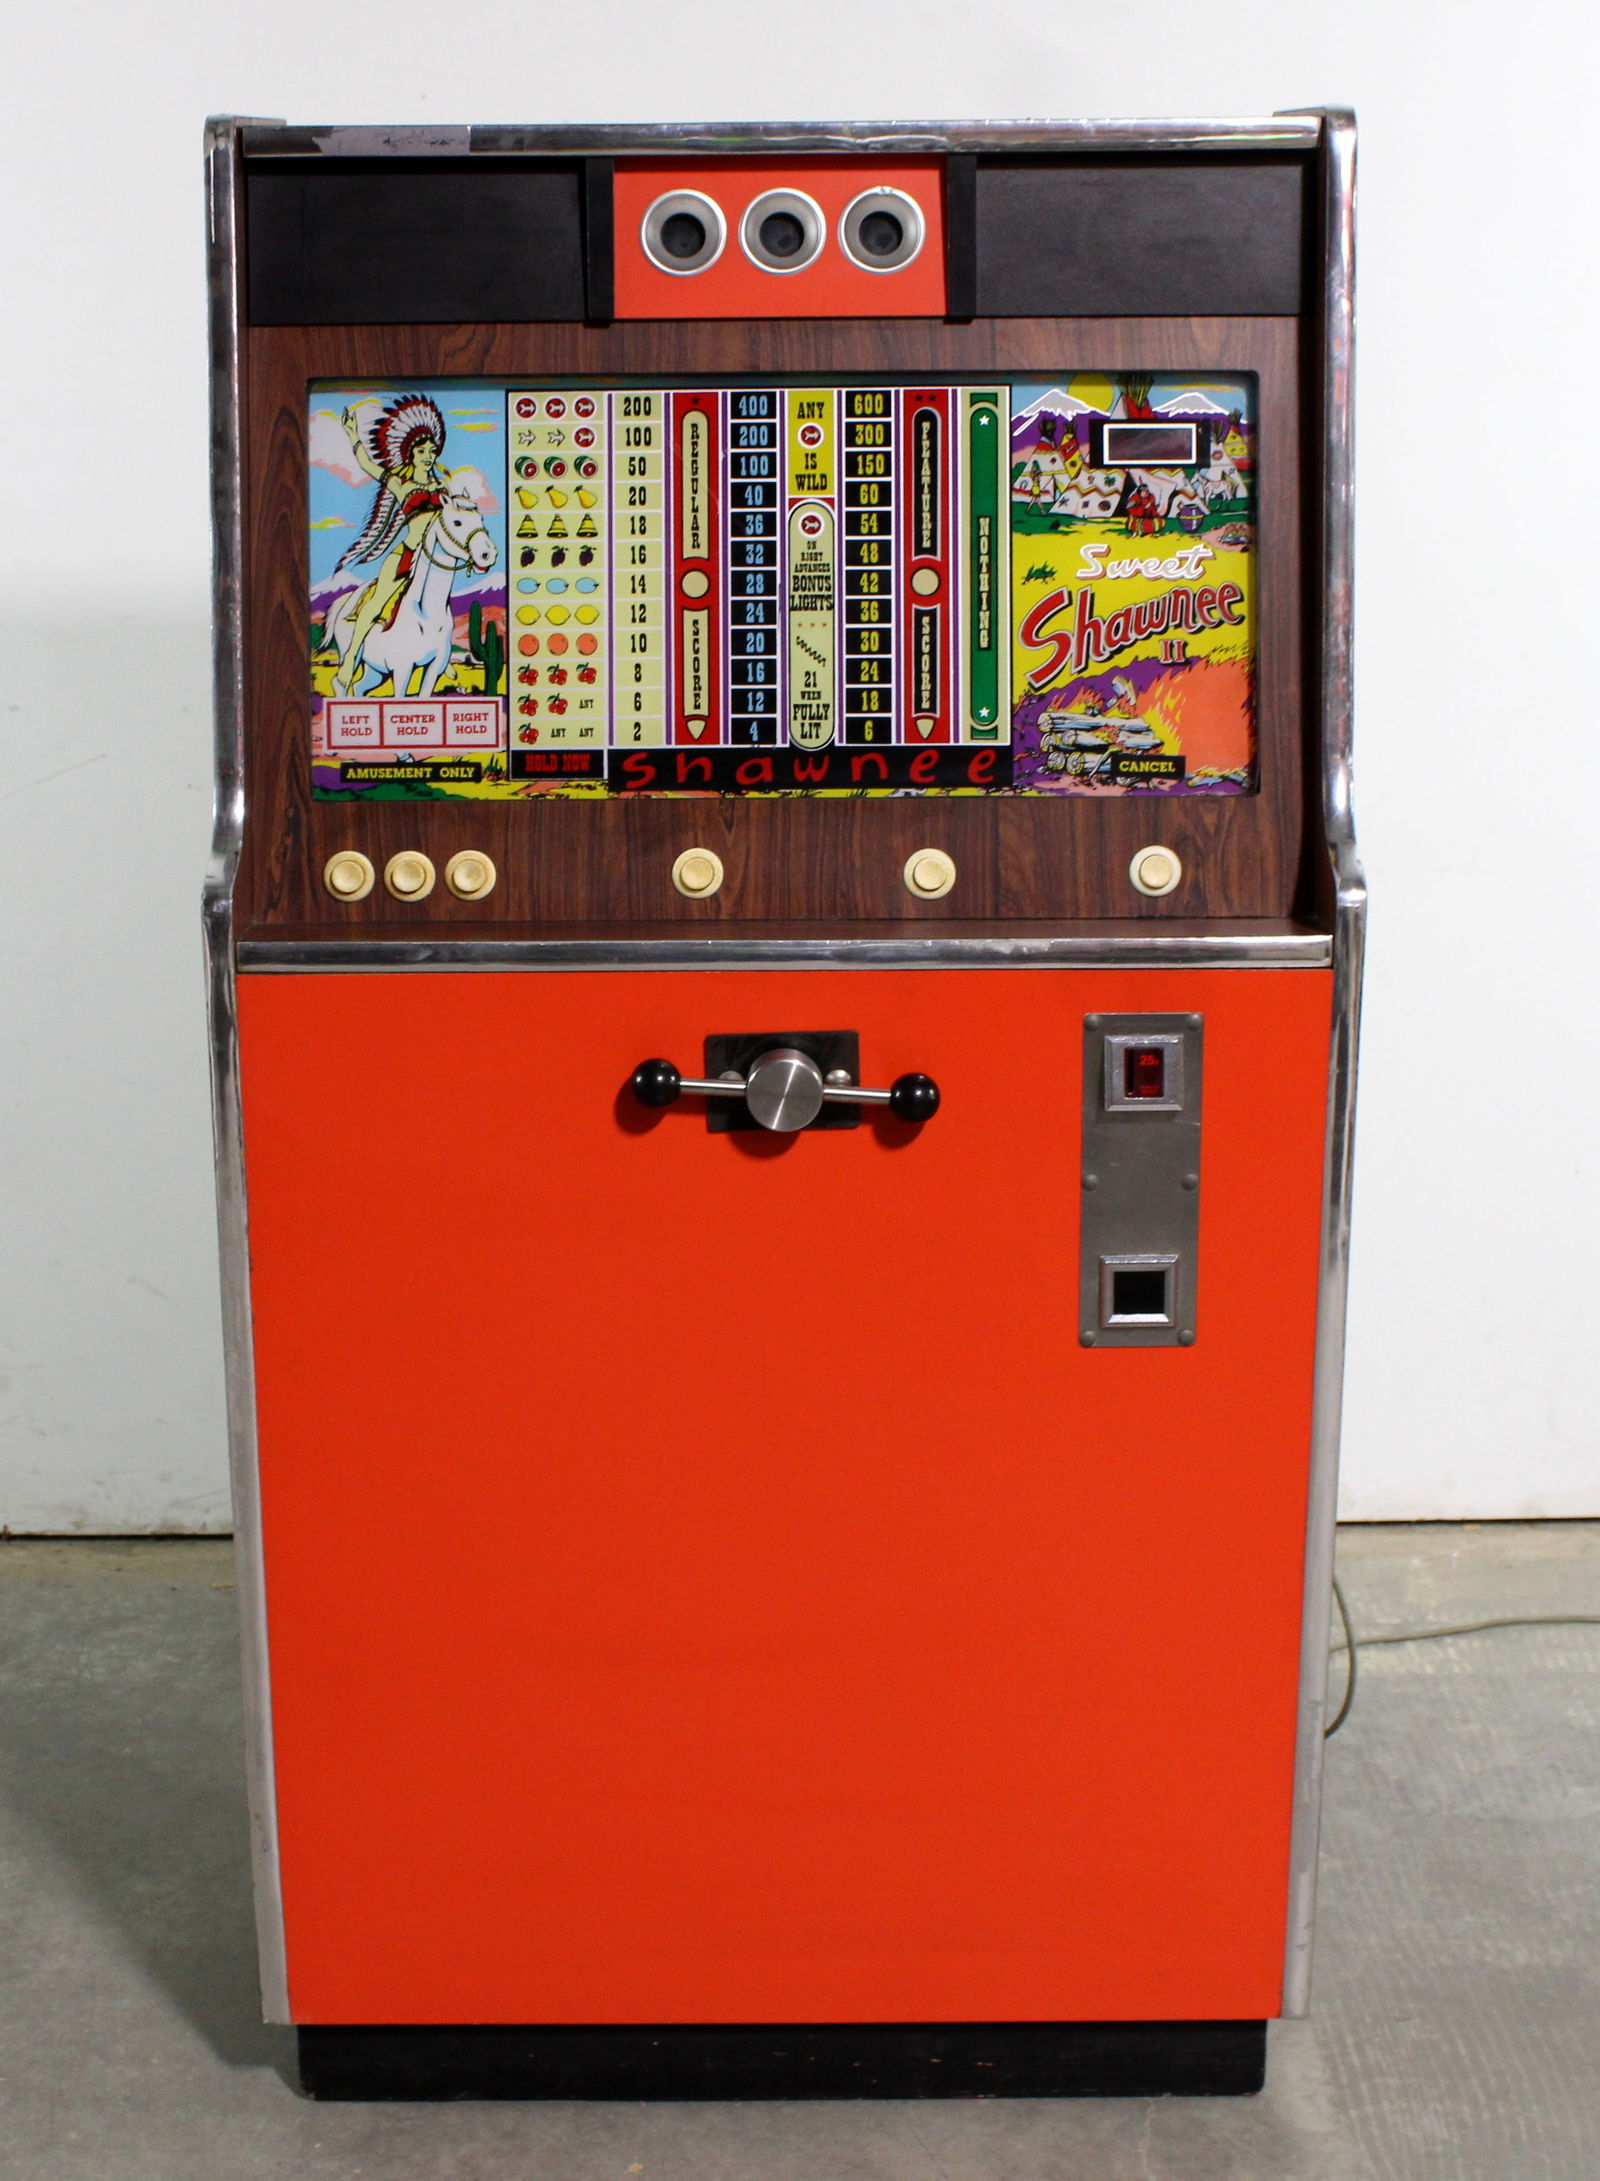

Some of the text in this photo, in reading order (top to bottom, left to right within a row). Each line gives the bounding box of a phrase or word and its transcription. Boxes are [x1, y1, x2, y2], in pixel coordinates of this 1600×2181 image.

[623, 396, 652, 416] 200
[739, 395, 768, 416] 400
[797, 402, 824, 419] ANY
[854, 393, 883, 415] 600
[625, 427, 652, 446] 100
[739, 425, 768, 446] 200
[855, 424, 884, 445] 300
[628, 456, 646, 476] 50
[740, 455, 769, 476] 100
[804, 453, 817, 470] IS
[857, 453, 884, 475] 150
[691, 423, 700, 549] REGULAR
[795, 474, 828, 491] WILD
[921, 421, 932, 548] FEATURE
[629, 486, 647, 506] 20
[744, 485, 763, 506] 40
[860, 483, 879, 505] 60
[630, 516, 647, 535] 18
[745, 514, 764, 535] 36
[860, 513, 878, 534] 54
[631, 545, 647, 564] 16
[745, 544, 764, 564] 32
[860, 542, 878, 563] 48
[1075, 543, 1215, 580] Sweet
[631, 575, 646, 594] 14
[745, 573, 764, 594] 28
[793, 575, 831, 592] BONUS
[860, 572, 879, 593] 42
[745, 602, 765, 623] 24
[790, 594, 833, 611] LIGHTS
[860, 601, 879, 622] 36
[631, 604, 647, 623] 12
[631, 634, 647, 653] 10
[746, 632, 764, 653] 20
[860, 631, 879, 652] 30
[1018, 582, 1244, 689] Shawnee
[1160, 640, 1187, 664] II
[692, 619, 702, 710] SCORE
[747, 662, 765, 683] 16
[860, 661, 879, 682] 24
[921, 616, 932, 709] SCORE
[634, 663, 642, 683] 8
[804, 671, 817, 688] 21
[634, 692, 642, 711] 6
[747, 691, 764, 712] 12
[800, 691, 821, 700] WHEN
[861, 690, 879, 711] 18
[342, 715, 370, 725] LEFT
[390, 714, 436, 724] CENTER
[453, 712, 489, 722] RIGHT
[793, 704, 830, 721] FULLY
[341, 727, 373, 737] HOLD
[396, 725, 429, 736] HOLD
[456, 724, 488, 734] HOLD
[634, 722, 641, 741] 2
[749, 721, 759, 741] 4
[800, 722, 821, 739] LIT
[864, 720, 873, 741] 6
[346, 766, 476, 779] AMUSEMENT ONLY
[525, 753, 592, 772] HOLD NOW
[1119, 761, 1176, 773] CANCEL
